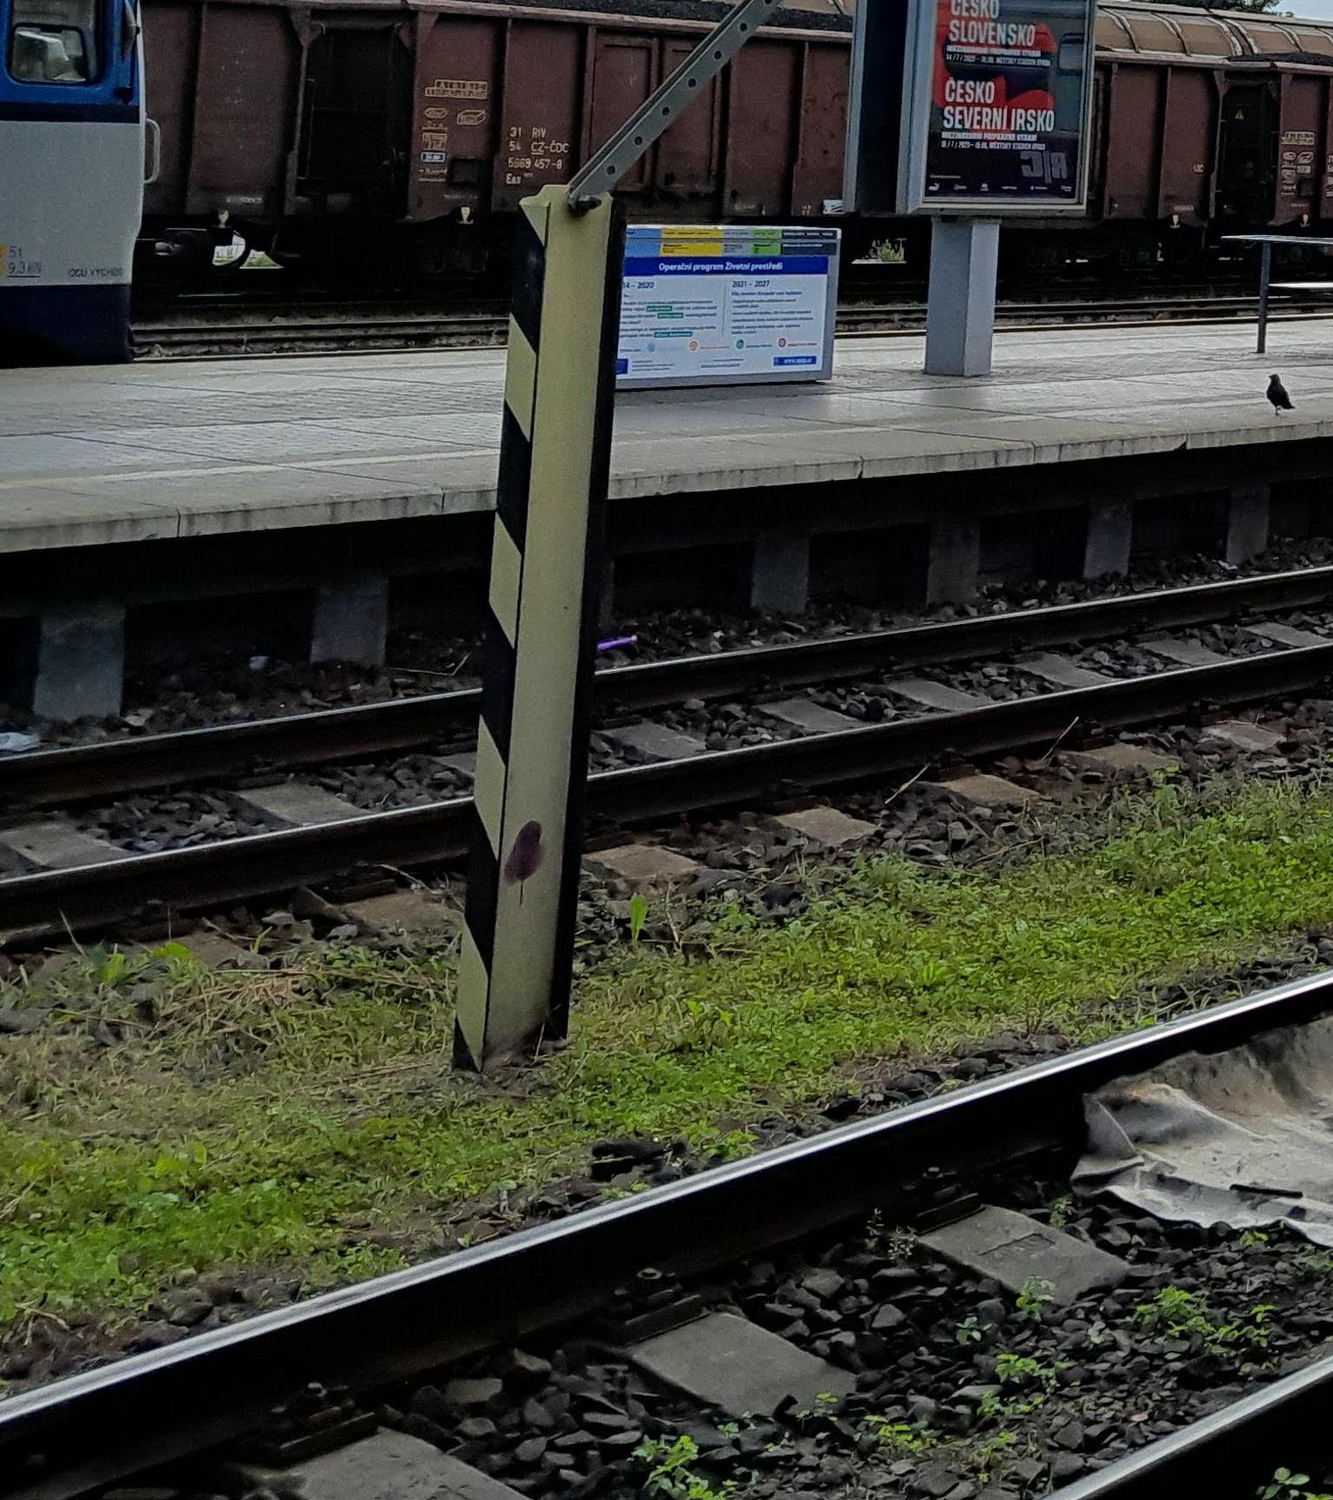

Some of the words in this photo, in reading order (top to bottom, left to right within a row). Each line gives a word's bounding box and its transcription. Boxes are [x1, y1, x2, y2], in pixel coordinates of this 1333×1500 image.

[948, 20, 1036, 47] SLOVENSKO
[944, 77, 995, 104] ČESKO
[943, 105, 1007, 130] SEVERNÍ
[1010, 109, 1055, 132] IRSKO
[510, 126, 522, 137] 31
[532, 127, 546, 138] RIV
[531, 140, 569, 155] CZ-ČDC
[658, 262, 692, 272] Operační
[693, 264, 724, 272] program
[725, 261, 750, 270] Životní
[751, 262, 783, 271] prostředí
